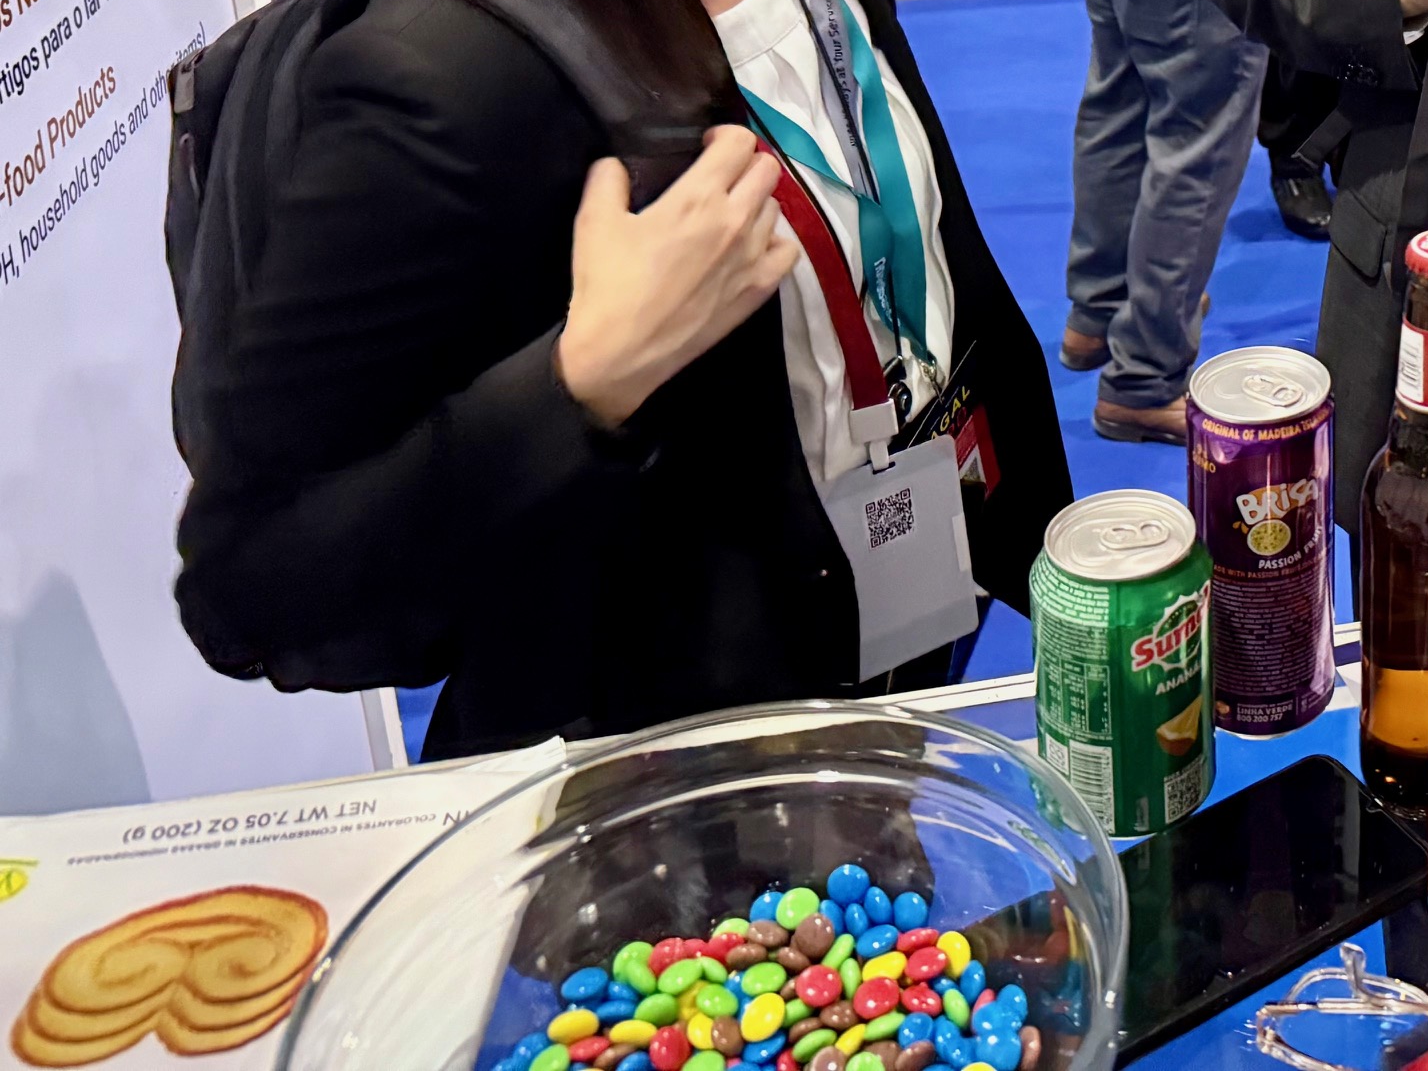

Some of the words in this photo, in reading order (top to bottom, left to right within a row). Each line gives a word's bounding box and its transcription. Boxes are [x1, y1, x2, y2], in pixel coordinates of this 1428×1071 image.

[41, 15, 73, 69] para
[73, 4, 83, 30] o
[47, 65, 118, 160] Products
[18, 156, 88, 264] household
[89, 120, 128, 187] goods
[127, 87, 150, 136] and
[1202, 418, 1240, 440] ORIGINAL
[1242, 430, 1255, 441] OF
[1258, 425, 1302, 441] MADEIRA
[1258, 550, 1302, 570] PASSION
[1247, 570, 1279, 580] PASSION
[1265, 704, 1294, 716] VERDE
[296, 806, 329, 825] WT
[335, 799, 378, 819] NET
[208, 816, 239, 835] OZ
[245, 810, 293, 829] 7.05
[357, 813, 437, 832] COLORANTES
[122, 826, 145, 845] g)
[150, 819, 201, 843] (200
[240, 826, 337, 845] CONSERVANTES
